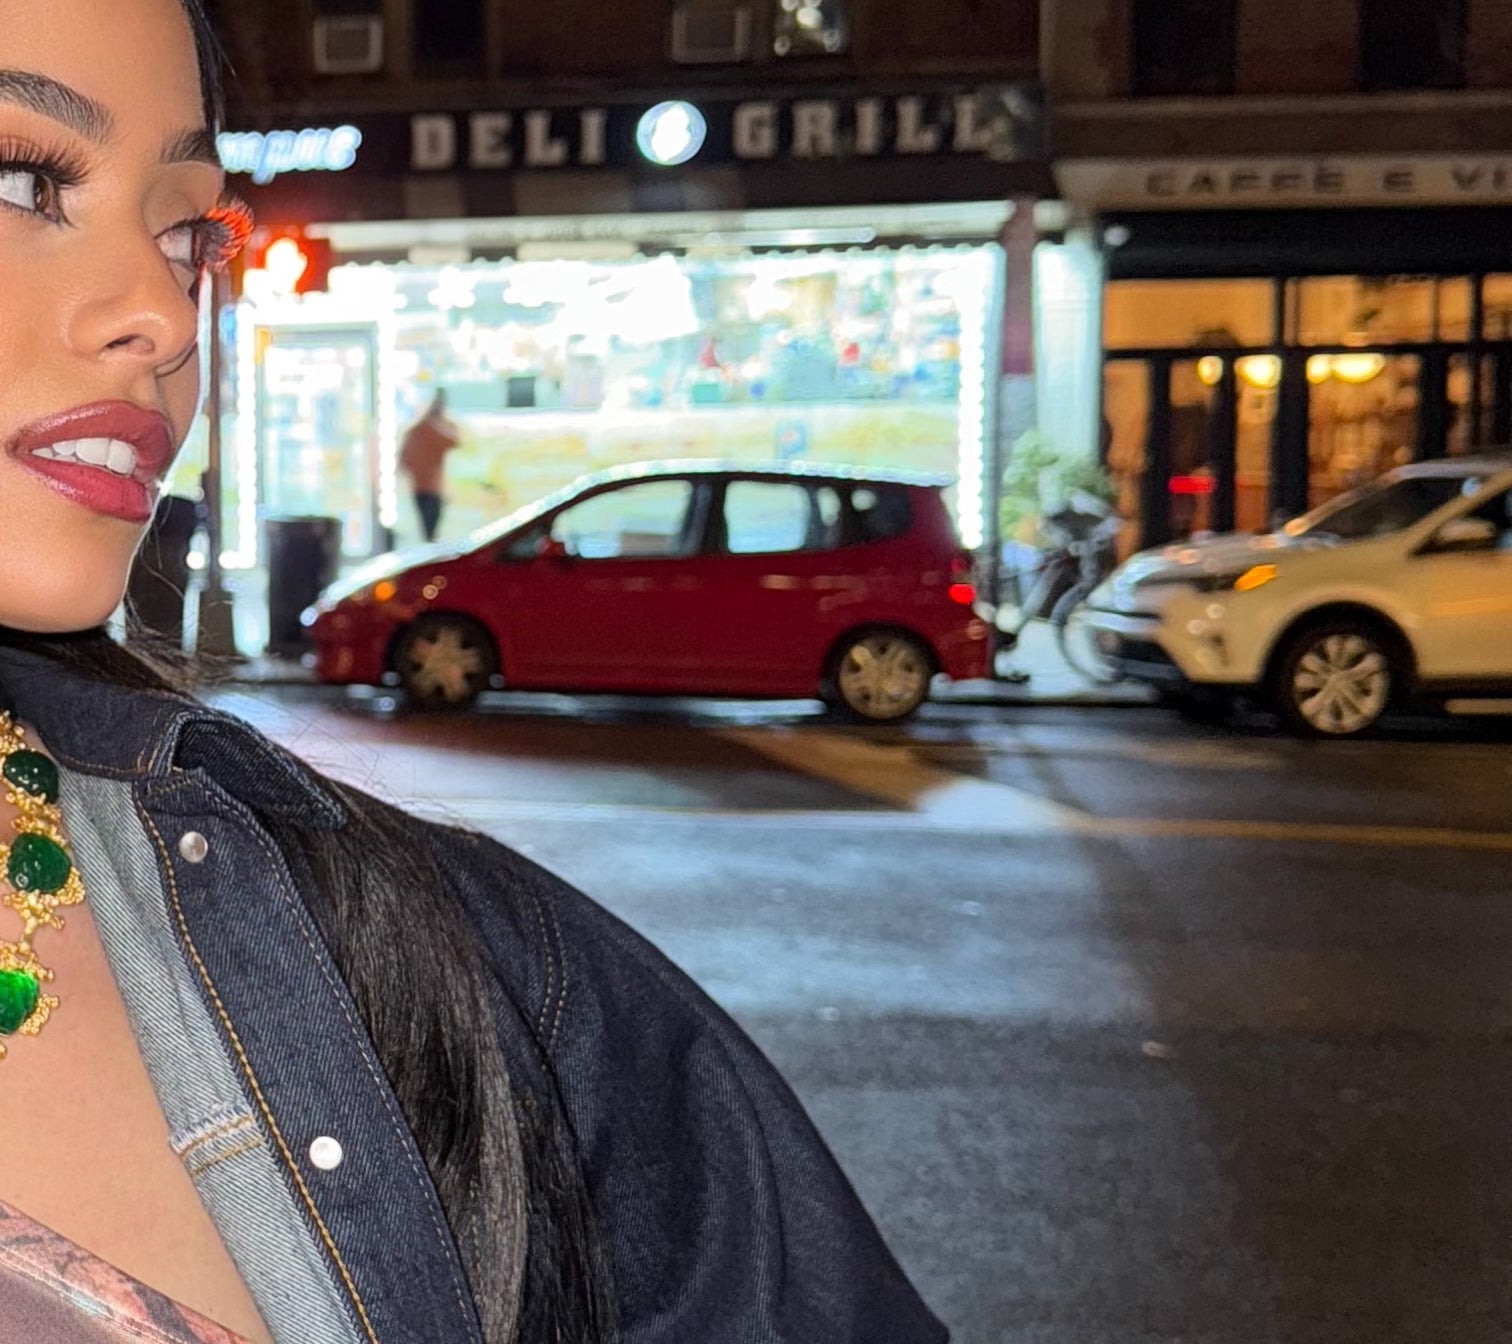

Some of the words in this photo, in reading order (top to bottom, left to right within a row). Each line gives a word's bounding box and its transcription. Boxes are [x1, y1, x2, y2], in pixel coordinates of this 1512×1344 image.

[410, 111, 606, 170] DELI
[733, 93, 994, 158] GRILL
[1382, 167, 1414, 193] E
